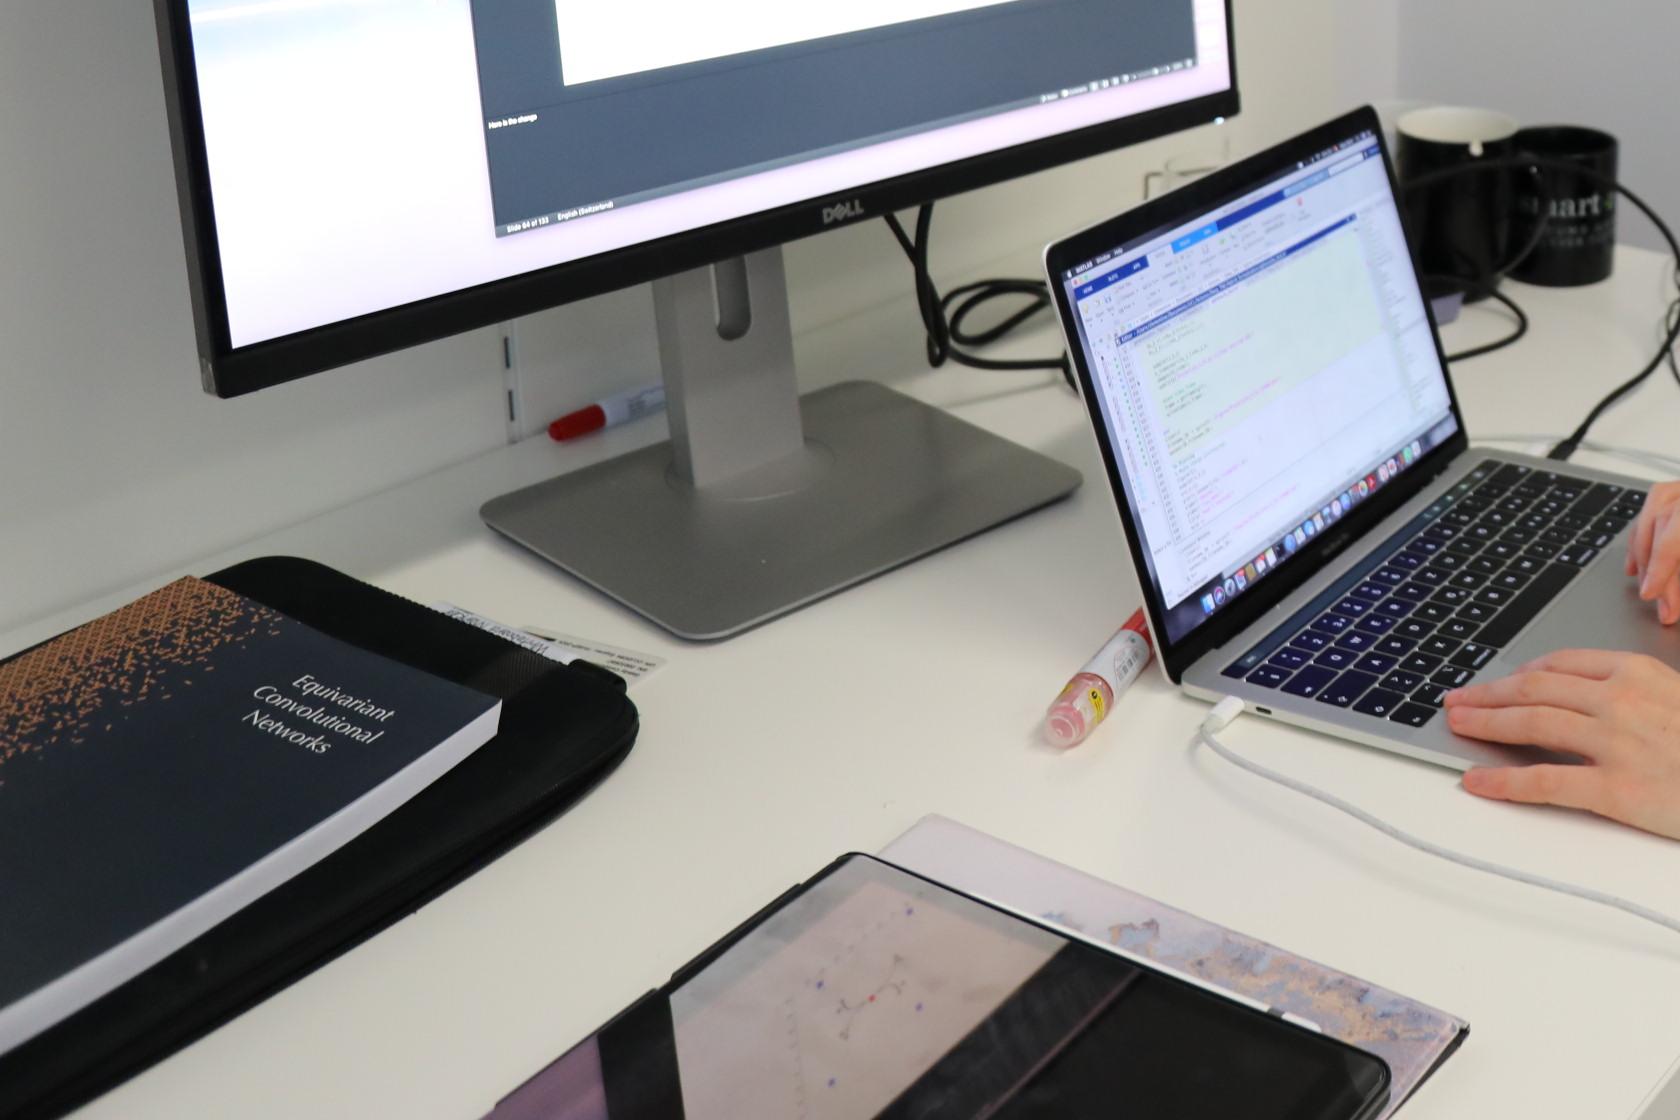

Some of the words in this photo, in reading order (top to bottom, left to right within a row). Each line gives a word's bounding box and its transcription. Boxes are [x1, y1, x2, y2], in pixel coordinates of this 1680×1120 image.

[557, 210, 578, 221] English
[822, 199, 864, 225] DELL
[253, 685, 385, 745] Convolutional
[292, 674, 396, 723] Equivariant
[241, 709, 332, 754] Networks
